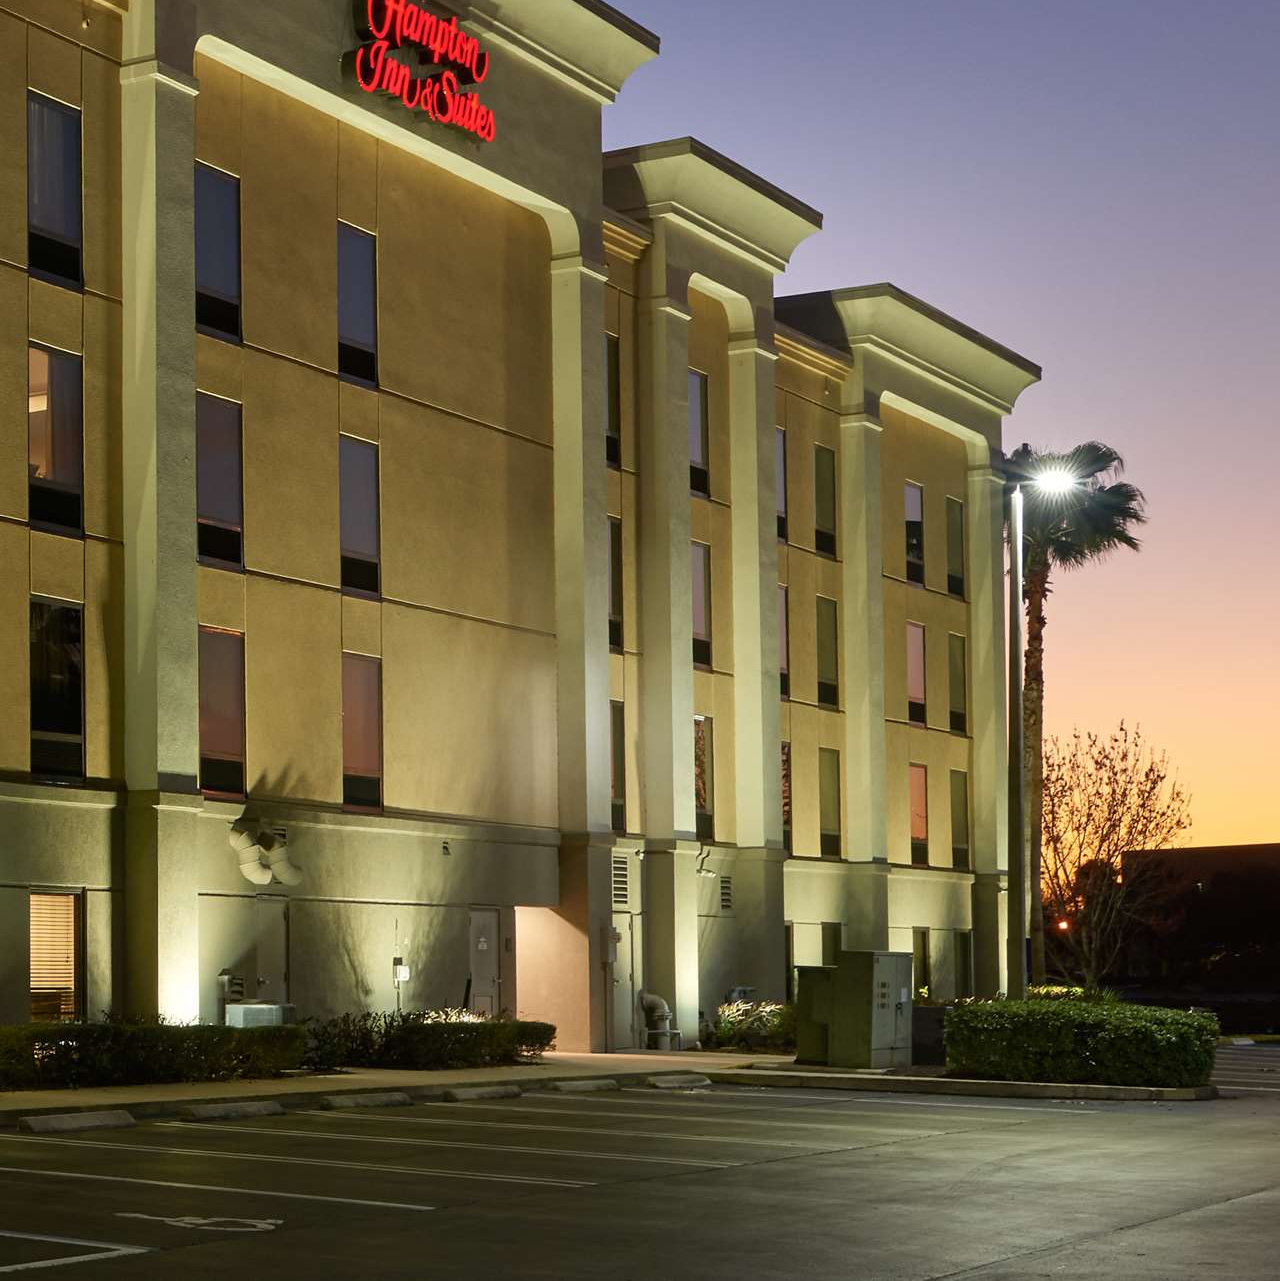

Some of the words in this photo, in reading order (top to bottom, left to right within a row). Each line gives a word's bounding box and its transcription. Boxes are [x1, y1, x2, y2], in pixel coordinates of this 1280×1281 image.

[356, 40, 420, 108] Inn
[421, 78, 436, 122] &
[434, 71, 496, 143] Suites
